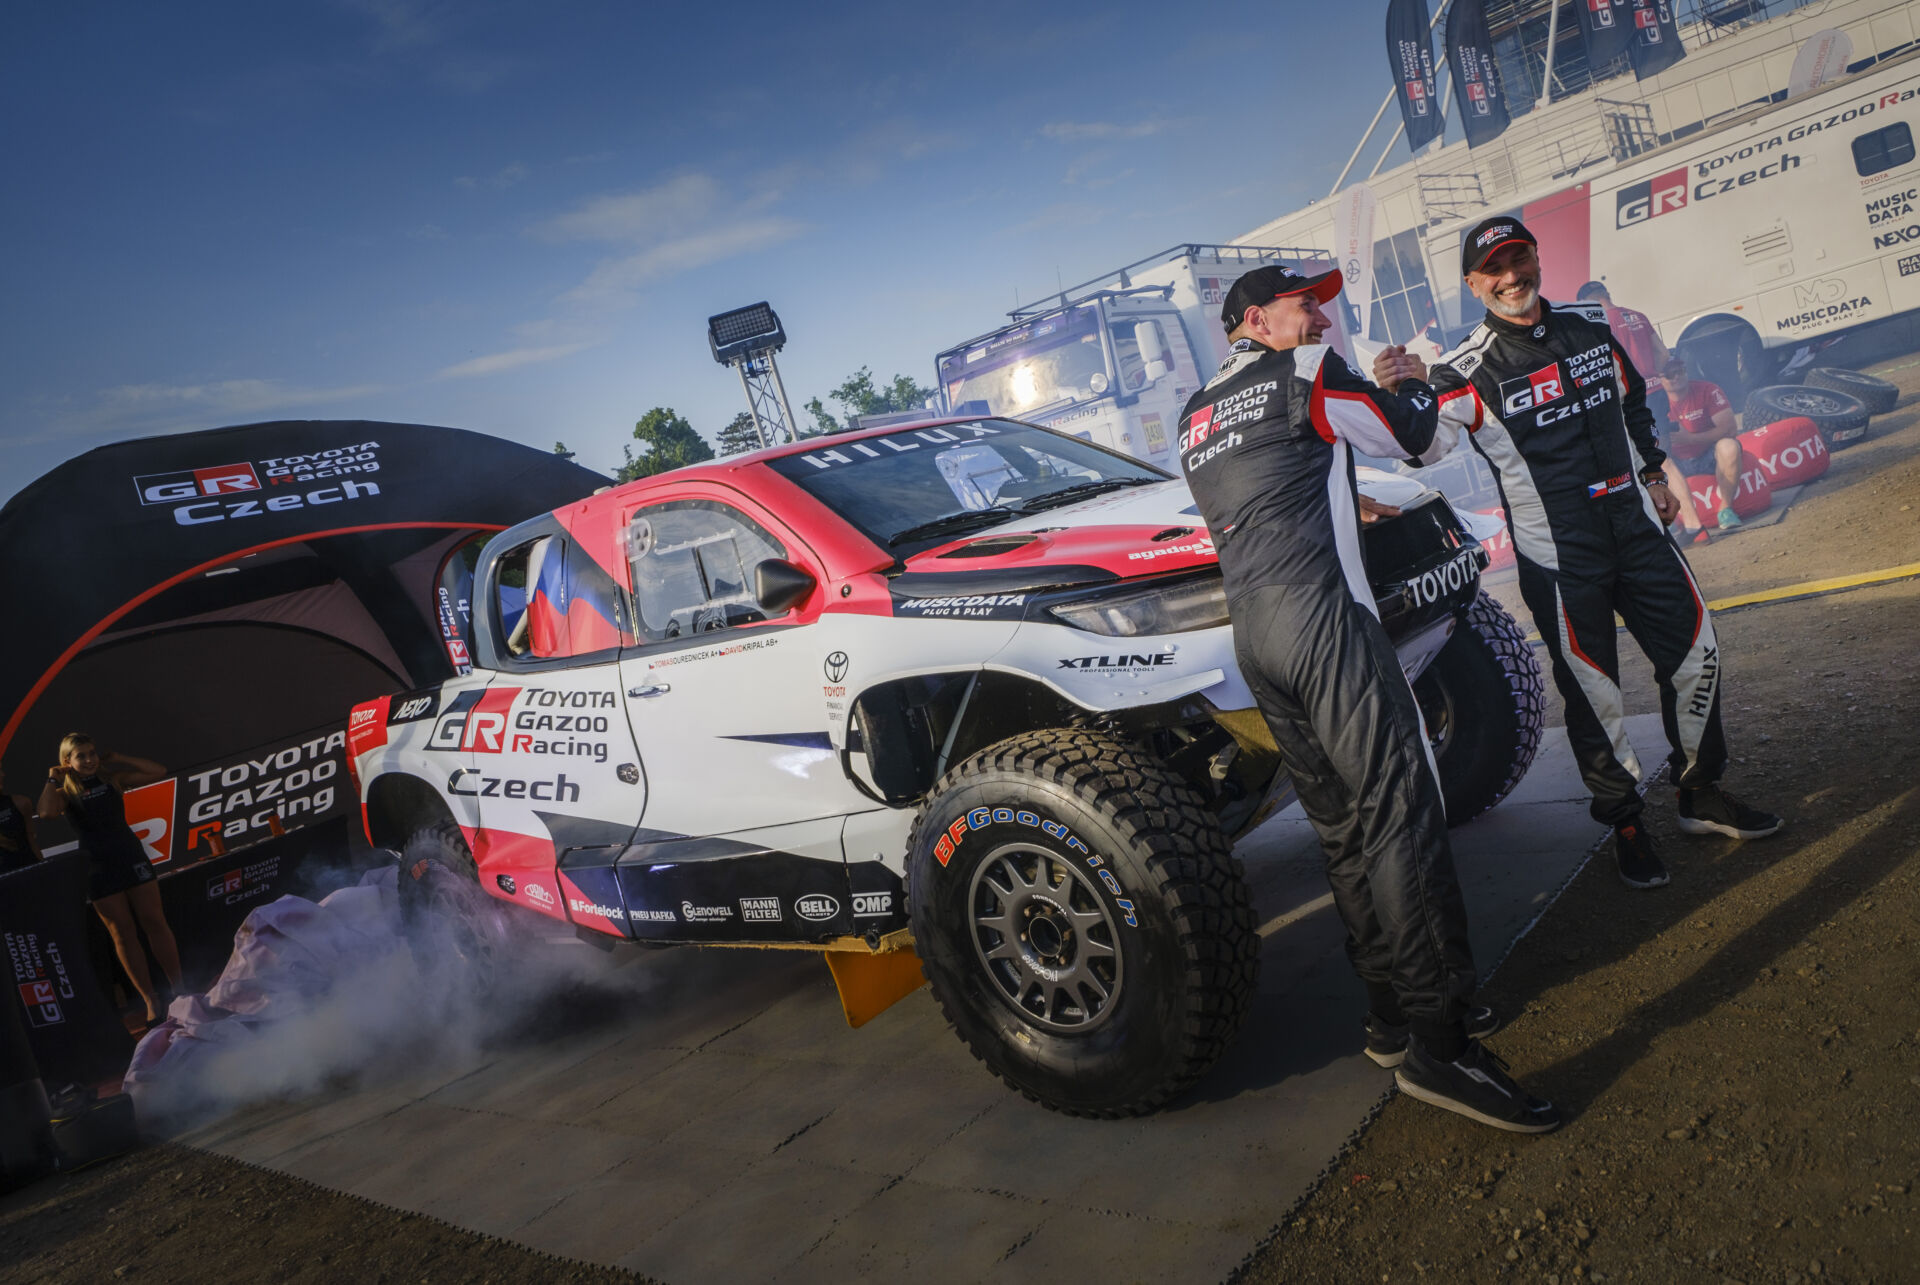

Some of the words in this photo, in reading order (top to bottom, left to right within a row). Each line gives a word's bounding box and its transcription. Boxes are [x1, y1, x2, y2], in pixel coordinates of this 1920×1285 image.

[1642, 11, 1660, 42] GR
[1398, 40, 1411, 80] TOYOTA
[1404, 42, 1416, 79] GAZOO
[1411, 41, 1420, 78] Racing
[1420, 49, 1435, 97] Czech
[1459, 46, 1470, 82] TOYOTA
[1464, 48, 1476, 81] GAZOO
[1471, 47, 1480, 80] Racing
[1481, 54, 1497, 98] Czech
[1413, 83, 1426, 114] GR
[1473, 84, 1488, 115] GR
[1694, 136, 1782, 172] TOYOTA
[1787, 102, 1876, 142] GAZOO
[1694, 153, 1801, 201] Czech
[1860, 173, 1889, 186] TOYOTA
[1618, 184, 1686, 227] GR
[1866, 188, 1919, 214] MUSIC
[1868, 203, 1914, 225] DATA
[1900, 254, 1920, 268] MA
[1202, 288, 1221, 304] GR
[1586, 311, 1604, 319] OMP
[1777, 296, 1872, 330] MUSICDATA
[1802, 320, 1823, 330] PLUG
[1833, 312, 1854, 322] PLAY
[1218, 358, 1238, 374] MP
[1458, 356, 1477, 371] OMP
[1574, 366, 1614, 388] Racing
[1212, 394, 1268, 423] GAZOO
[1216, 381, 1277, 411] TOYOTA
[1505, 379, 1561, 414] GR
[1052, 407, 1098, 426] Racing
[1211, 407, 1264, 435] Racing
[801, 422, 1001, 469] HILUX
[1179, 421, 1209, 455] GR
[1188, 432, 1243, 472] Czech
[258, 441, 380, 468] TOYOTA
[265, 452, 376, 478] GAZOO
[269, 461, 380, 485] Racing
[1607, 472, 1631, 487] TOMAS
[144, 474, 255, 501] GR
[173, 480, 381, 526] Czech
[1128, 543, 1204, 560] agados
[1407, 552, 1480, 608] TOYOTA
[438, 587, 459, 636] Racing
[900, 593, 1026, 610] MUSICDATA
[922, 607, 950, 616] PLUG
[953, 607, 962, 616] &
[964, 607, 993, 616] PLAY
[1056, 652, 1176, 669] XTLINE
[525, 688, 616, 709] TOYOTA
[823, 686, 846, 697] TOYOTA
[352, 709, 377, 726] TOYOTA
[392, 696, 432, 720] NEXO
[515, 710, 608, 733] GAZOO
[430, 712, 504, 750] GR
[511, 733, 608, 763] Racing
[188, 730, 346, 795] TOYOTA
[188, 760, 337, 824] GAZOO
[448, 768, 581, 803] Czech
[187, 786, 335, 851] Racing
[243, 856, 281, 872] TOYOTA
[244, 863, 279, 879] GAZOO
[244, 870, 279, 886] Racing
[934, 806, 1139, 928] BFGoodrich
[209, 877, 240, 897] GR
[225, 883, 270, 905] Czech
[579, 901, 624, 920] Fortelock
[630, 910, 650, 920] PNEU
[650, 910, 676, 920] KAFKA
[742, 900, 777, 910] MANN
[745, 909, 779, 920] FILTER
[800, 900, 834, 913] BELL
[852, 895, 892, 913] OMP
[4, 932, 26, 981] TOYOTA
[16, 935, 37, 979] GAZOO
[27, 933, 46, 977] Racing
[46, 942, 75, 999] Czech
[33, 982, 61, 1022] GR
